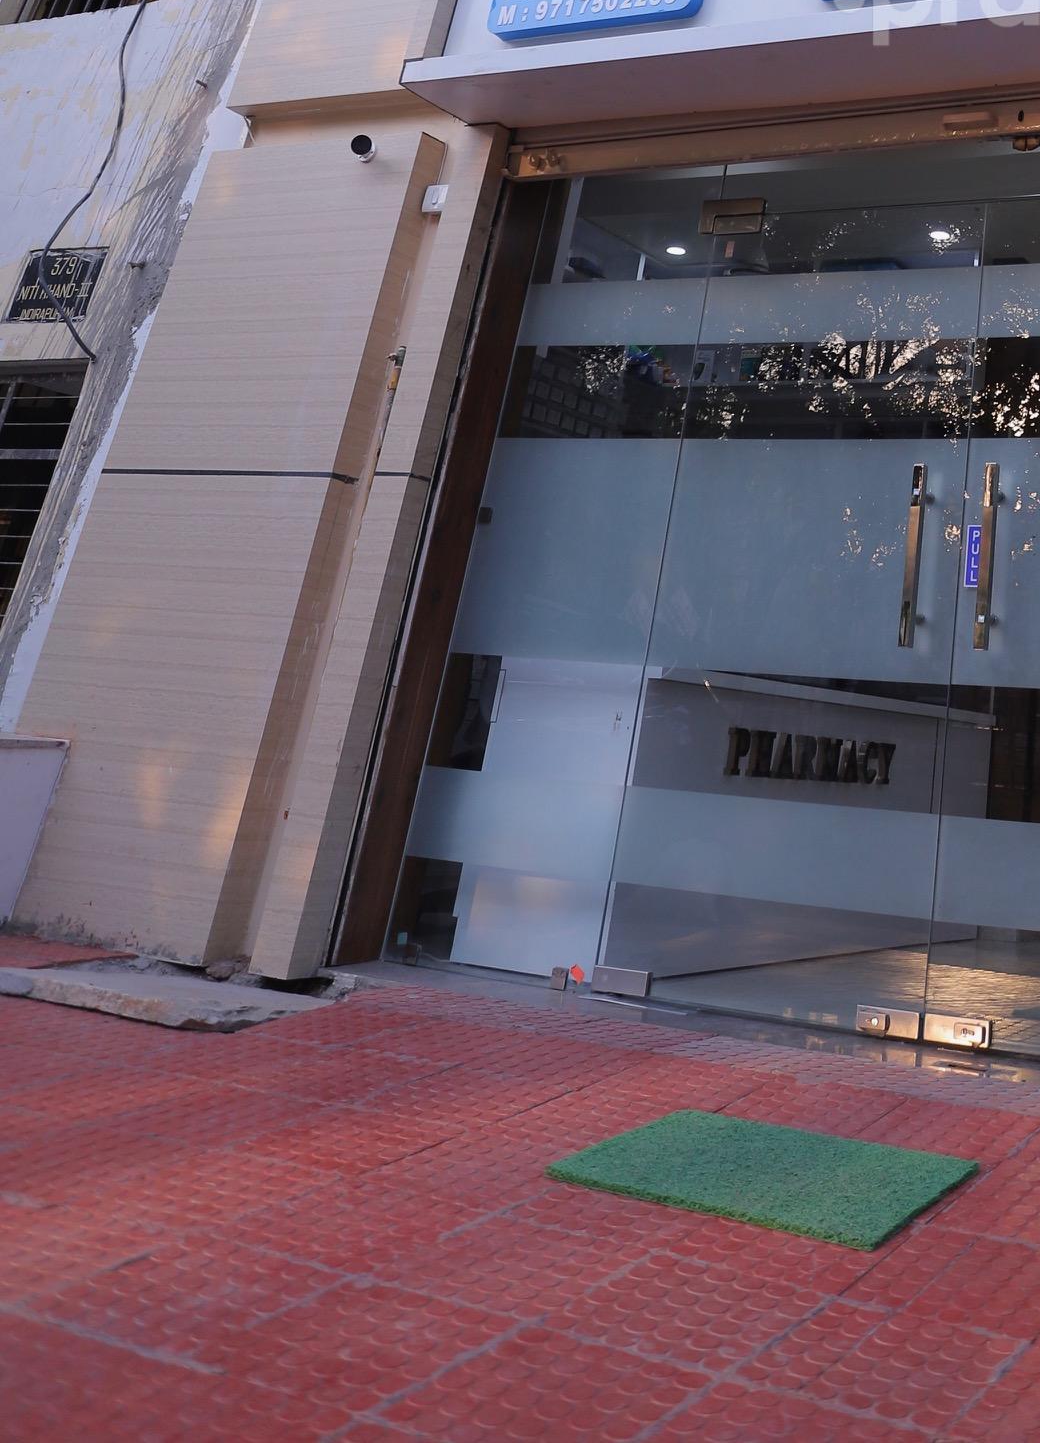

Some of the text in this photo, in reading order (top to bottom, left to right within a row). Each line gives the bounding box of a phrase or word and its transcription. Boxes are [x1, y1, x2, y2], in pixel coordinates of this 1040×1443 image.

[51, 256, 78, 276] 379
[19, 307, 76, 320] INDIRAPUM
[970, 531, 981, 582] PULL
[723, 726, 897, 785] PHARMACY
